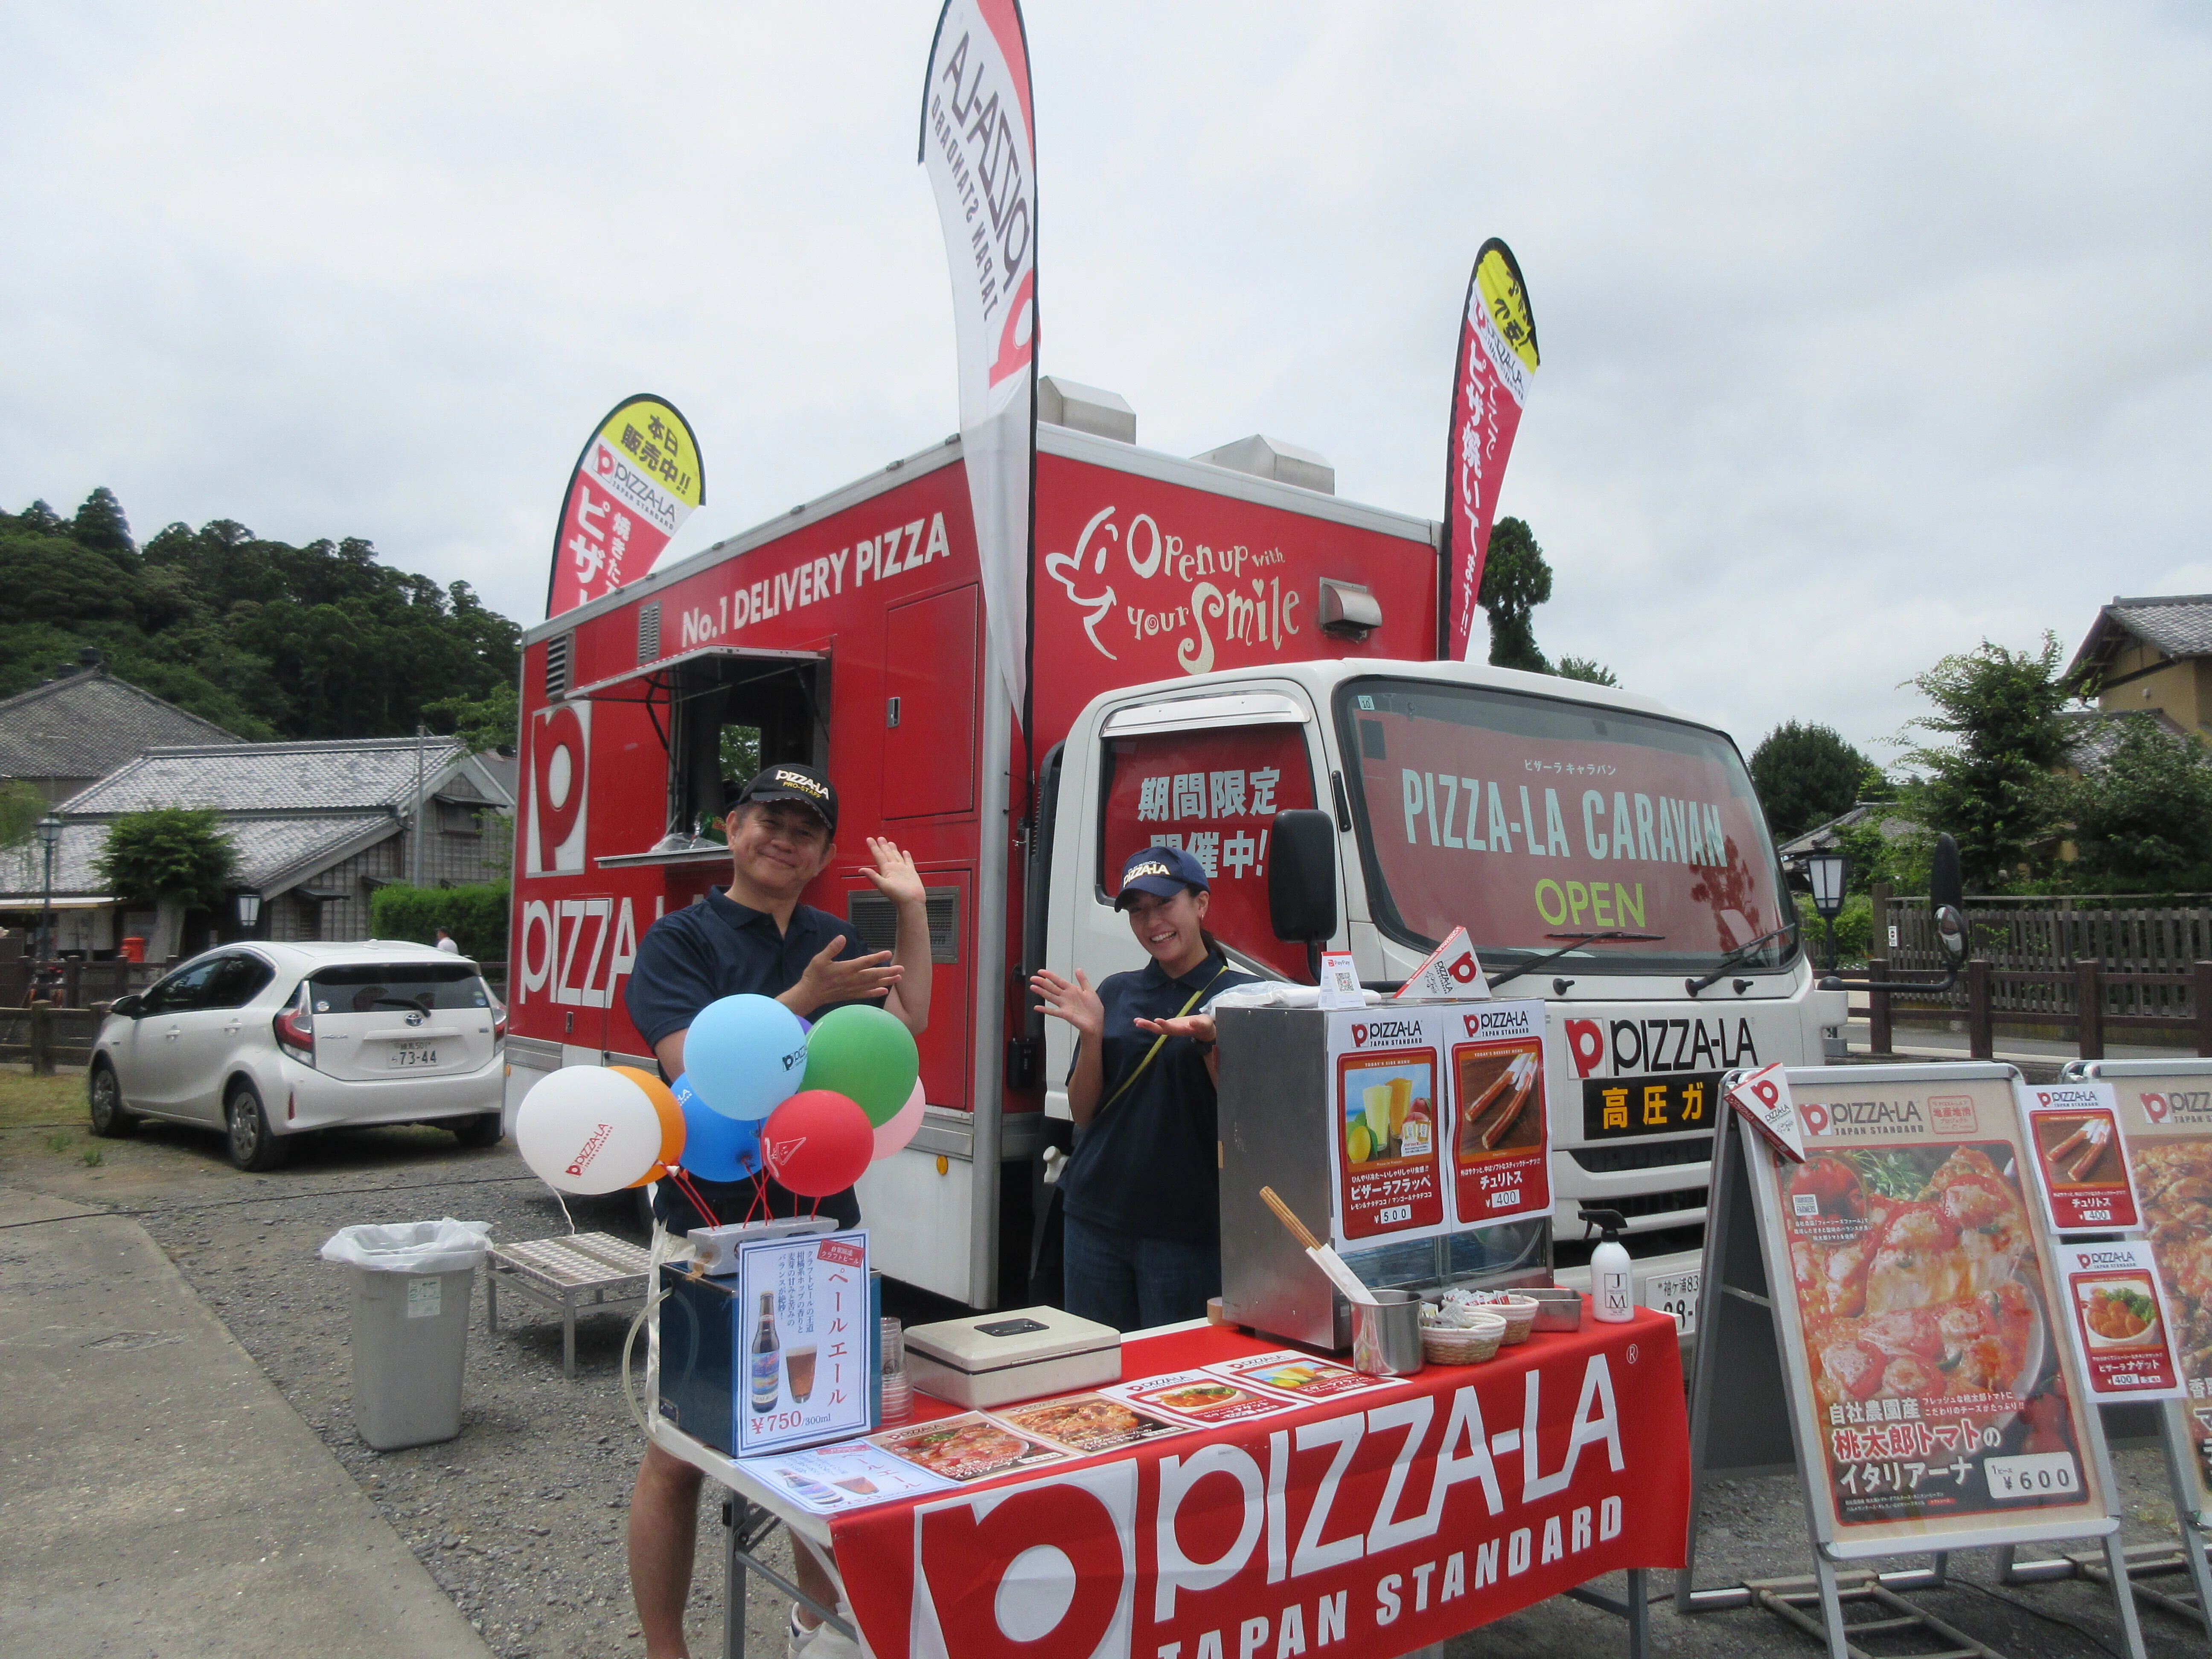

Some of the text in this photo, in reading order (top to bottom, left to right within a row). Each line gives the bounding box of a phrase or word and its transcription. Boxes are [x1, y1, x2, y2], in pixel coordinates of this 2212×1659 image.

[648, 414, 678, 457] 本日
[621, 423, 691, 495] 販売中!!
[733, 547, 850, 630] DELIVERY
[856, 512, 950, 587] PIZZA
[1220, 545, 1248, 577] up
[1252, 547, 1286, 568] with
[1127, 576, 1300, 675] your Smile
[1525, 759, 1616, 775] ピザーラ キャラバン
[775, 770, 829, 800] PIZZA-LA
[1137, 766, 1281, 822] 期間限定
[1402, 768, 1728, 868] PIZZA-LA CARAVAN
[1534, 877, 1646, 928] OPEN
[519, 895, 664, 1009] PIZZA
[1370, 1020, 1422, 1039] PIZZA-LA
[1481, 1011, 1528, 1029] PIZZA-LA
[1502, 1027, 1529, 1036] STANDARD
[399, 1050, 437, 1065] 73-44
[1391, 1038, 1422, 1046] STANDARD
[1609, 1017, 1758, 1077] PIZZA-LA
[1602, 1082, 1704, 1130] 高圧ガ
[1831, 1100, 1923, 1125] PIZZA-LA
[2052, 1091, 2097, 1102] PIZZA-LA
[2169, 1091, 2212, 1114] PIZZ
[574, 1123, 609, 1166] PIZZA-LA
[1835, 1124, 1924, 1136] JAPAN STANDARD
[1351, 1175, 1431, 1200] ピザーラフラッペ
[1480, 1171, 1522, 1190] チュリトス
[822, 1251, 859, 1264] クラフトビール
[1663, 1275, 1700, 1296] 袖ヶ浦83
[827, 1268, 849, 1406] ペールエール
[1829, 1397, 1921, 1426] 自社農園産
[1832, 1417, 2002, 1462] 桃太郎トマトの
[1155, 1353, 1625, 1622] PIZZA-LA
[1840, 1456, 1974, 1494] イタリアーナ
[1376, 1495, 1623, 1625] STANDARD
